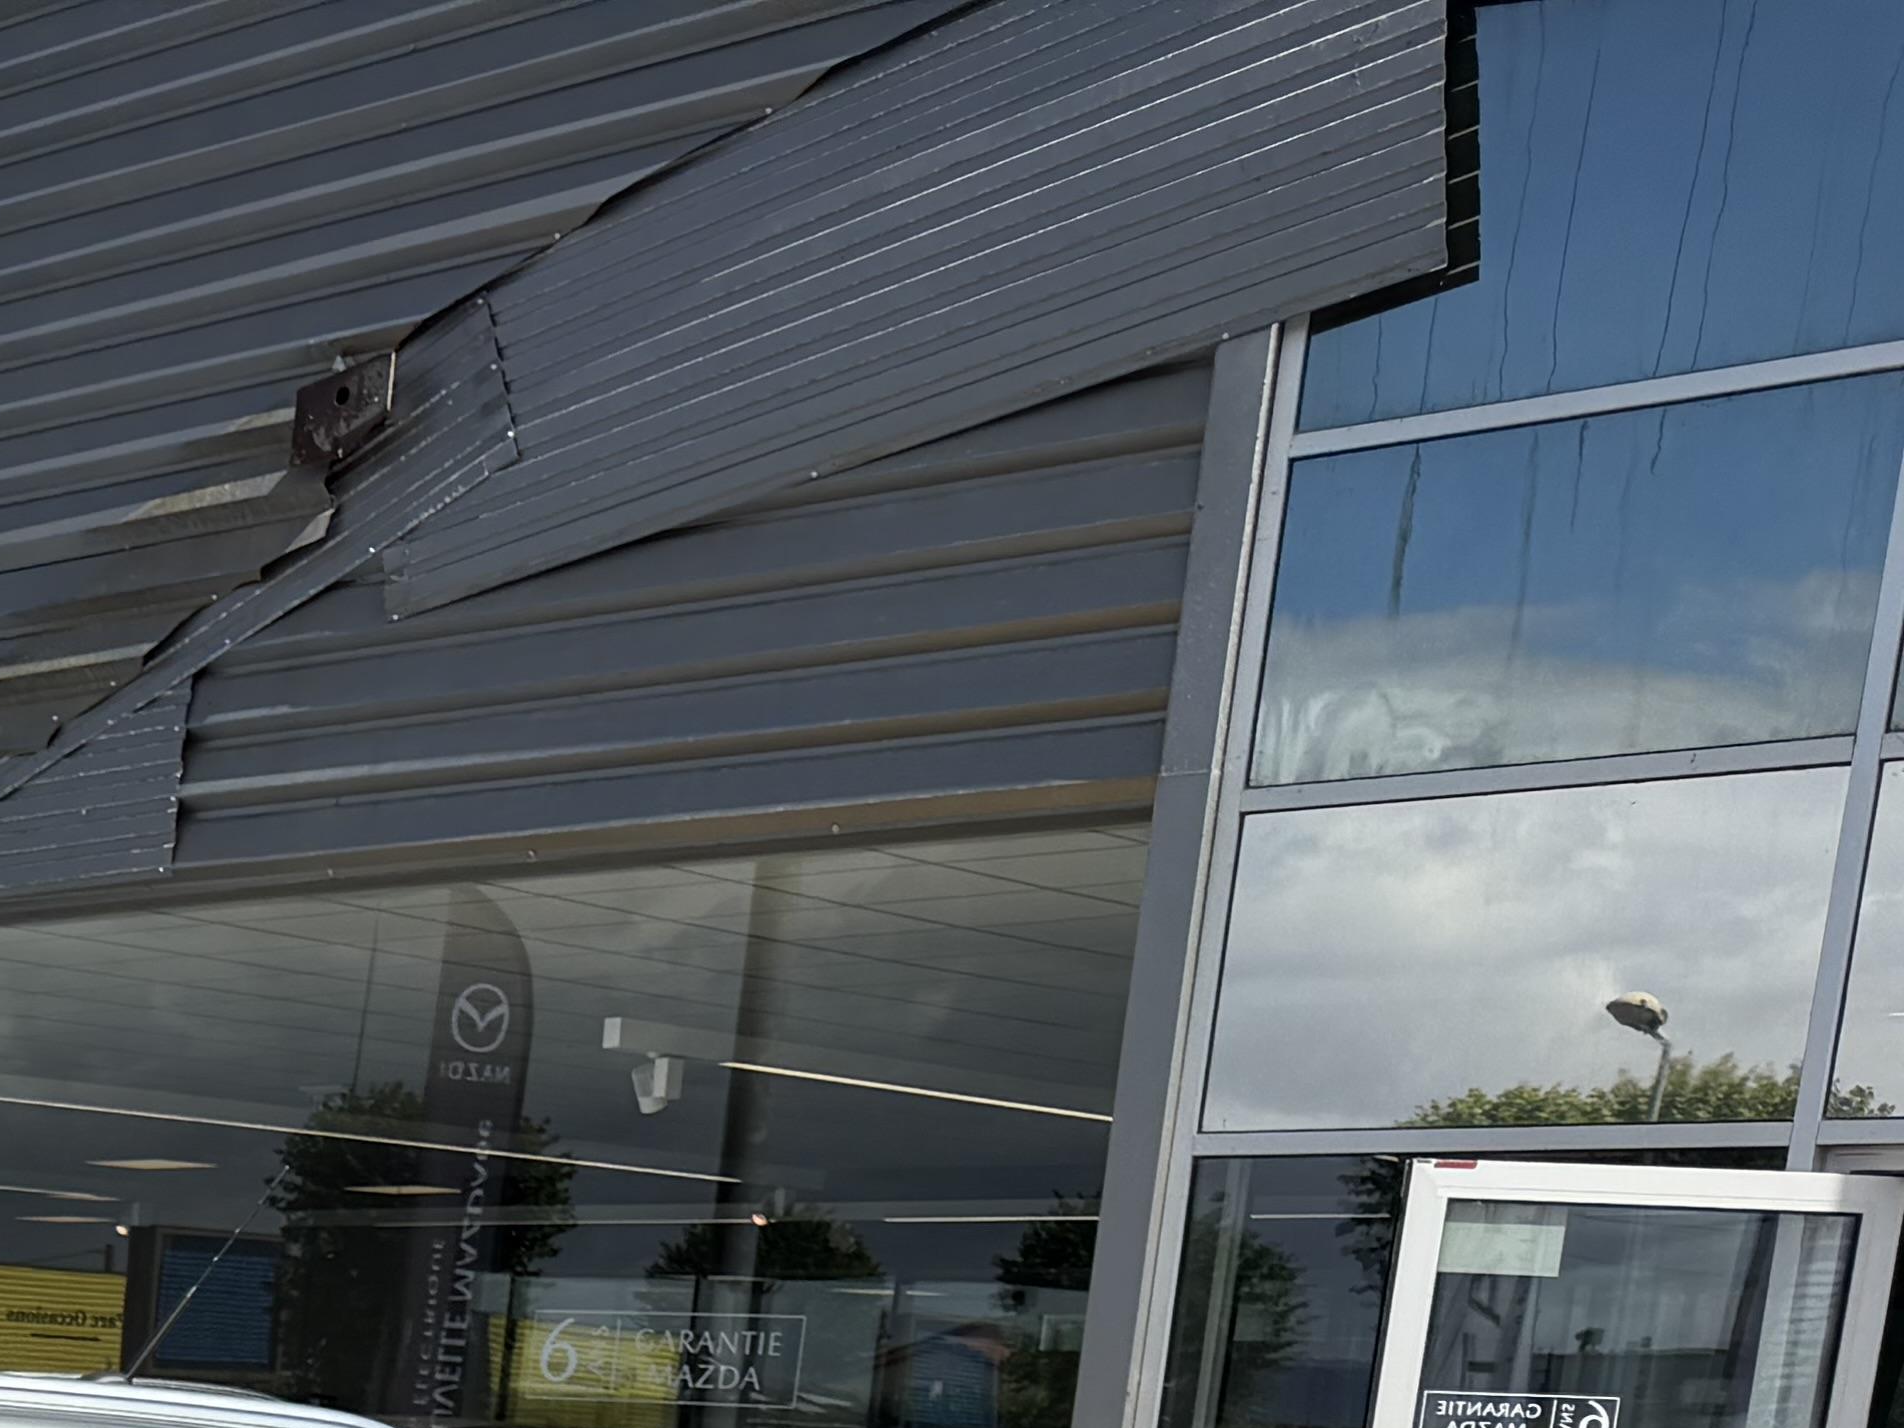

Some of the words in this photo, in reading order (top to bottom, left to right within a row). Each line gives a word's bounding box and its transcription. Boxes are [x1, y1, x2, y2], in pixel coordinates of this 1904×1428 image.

[541, 1317, 578, 1383] 6
[634, 1328, 783, 1357] GARANTIE
[651, 1362, 761, 1391] MAZDA
